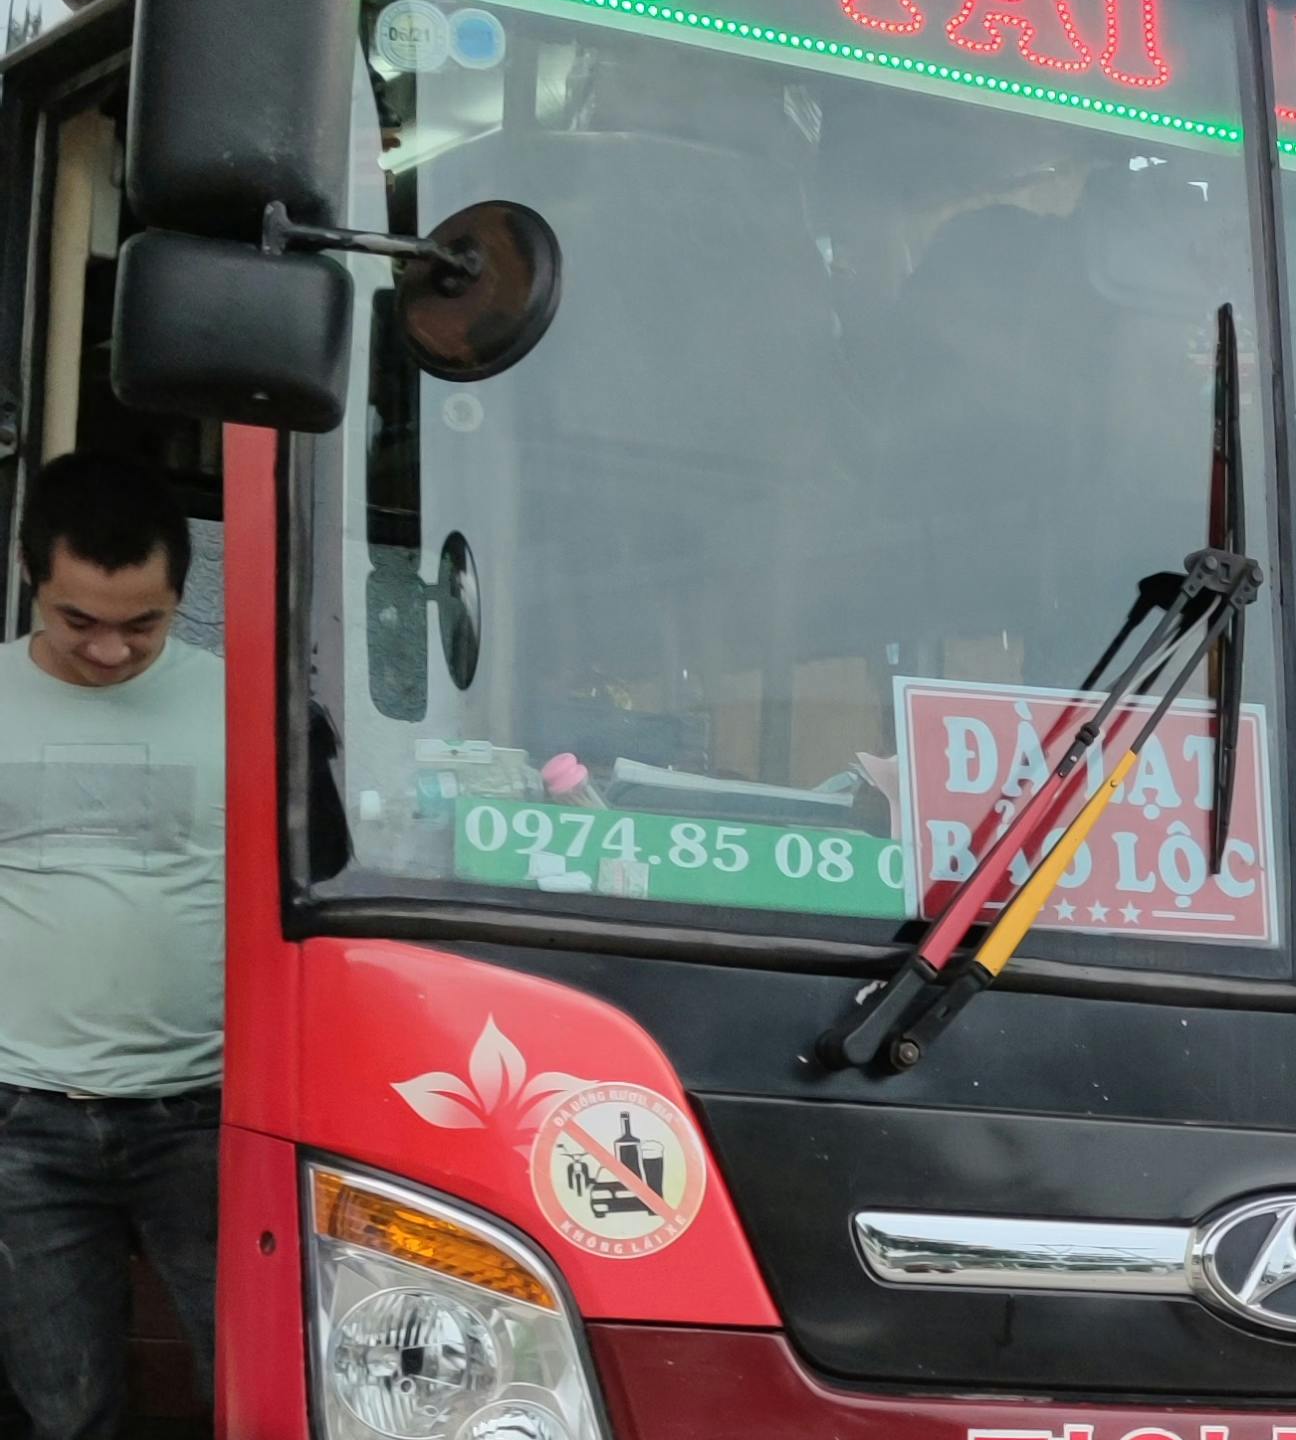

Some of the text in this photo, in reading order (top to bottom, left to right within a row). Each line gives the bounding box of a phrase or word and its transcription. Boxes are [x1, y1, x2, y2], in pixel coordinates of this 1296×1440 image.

[941, 700, 1054, 799] ĐÀ
[464, 805, 751, 873] 0974.85
[773, 832, 855, 884] 08
[1111, 819, 1257, 909] LỘC
[559, 1218, 624, 1255] KHÔNG
[665, 1213, 688, 1237] XE
